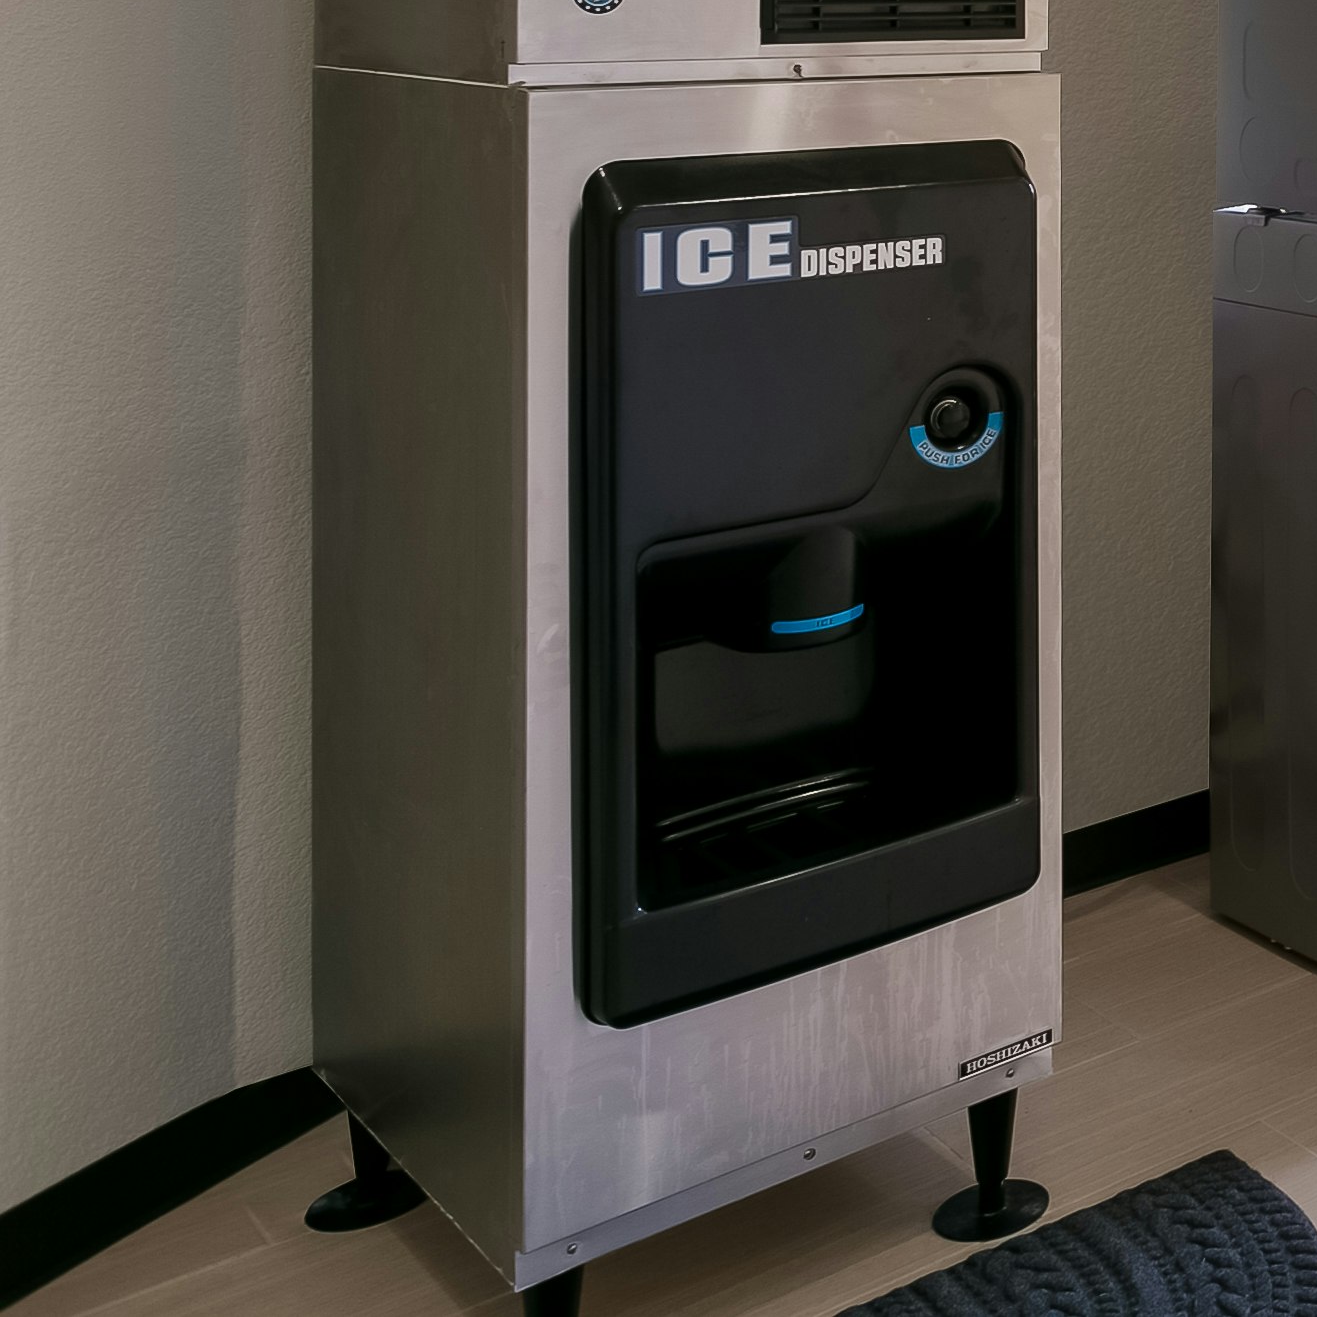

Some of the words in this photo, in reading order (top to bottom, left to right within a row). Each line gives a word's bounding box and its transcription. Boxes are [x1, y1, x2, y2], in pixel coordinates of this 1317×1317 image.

[643, 220, 792, 292] ICE
[800, 237, 943, 278] DISPENSER
[919, 442, 949, 464] PUSH
[955, 448, 979, 464] FOR
[981, 430, 996, 449] ICE
[966, 1032, 1047, 1074] HOSHIZAKI
